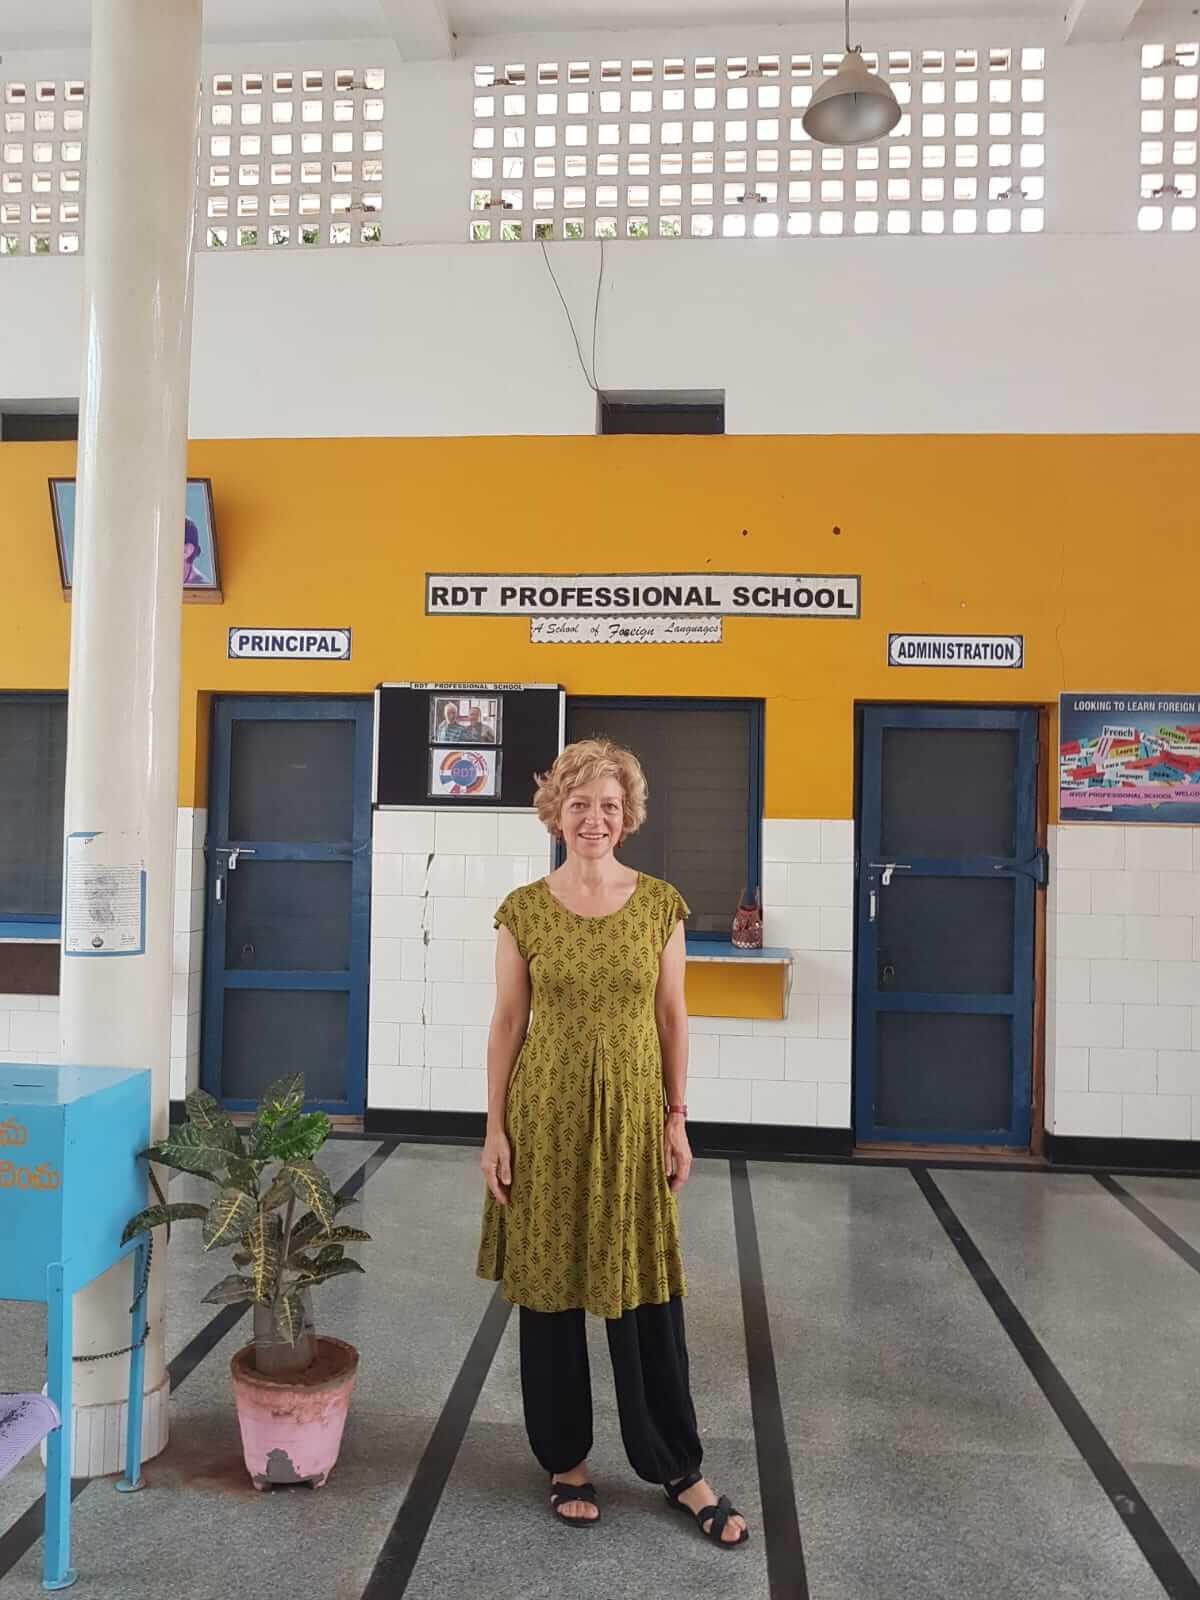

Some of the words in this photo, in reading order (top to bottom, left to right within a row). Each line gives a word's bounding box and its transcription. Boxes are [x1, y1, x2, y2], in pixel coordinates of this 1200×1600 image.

[430, 586, 488, 607] RDT
[500, 586, 721, 607] PROFESSIONAL
[732, 586, 854, 609] SCHOOL
[532, 623, 543, 634] A
[546, 622, 580, 634] School
[590, 623, 601, 635] of
[608, 623, 655, 640] Foreign
[664, 621, 719, 634] Languages
[238, 635, 341, 652] PRINCIPAL
[897, 641, 1014, 660] ADMINISTRATION
[1073, 700, 1111, 712] LOOKING
[1114, 701, 1125, 712] TO
[1127, 701, 1156, 712] LEARN
[1158, 701, 1195, 713] FOREIGN
[1103, 727, 1133, 738] French
